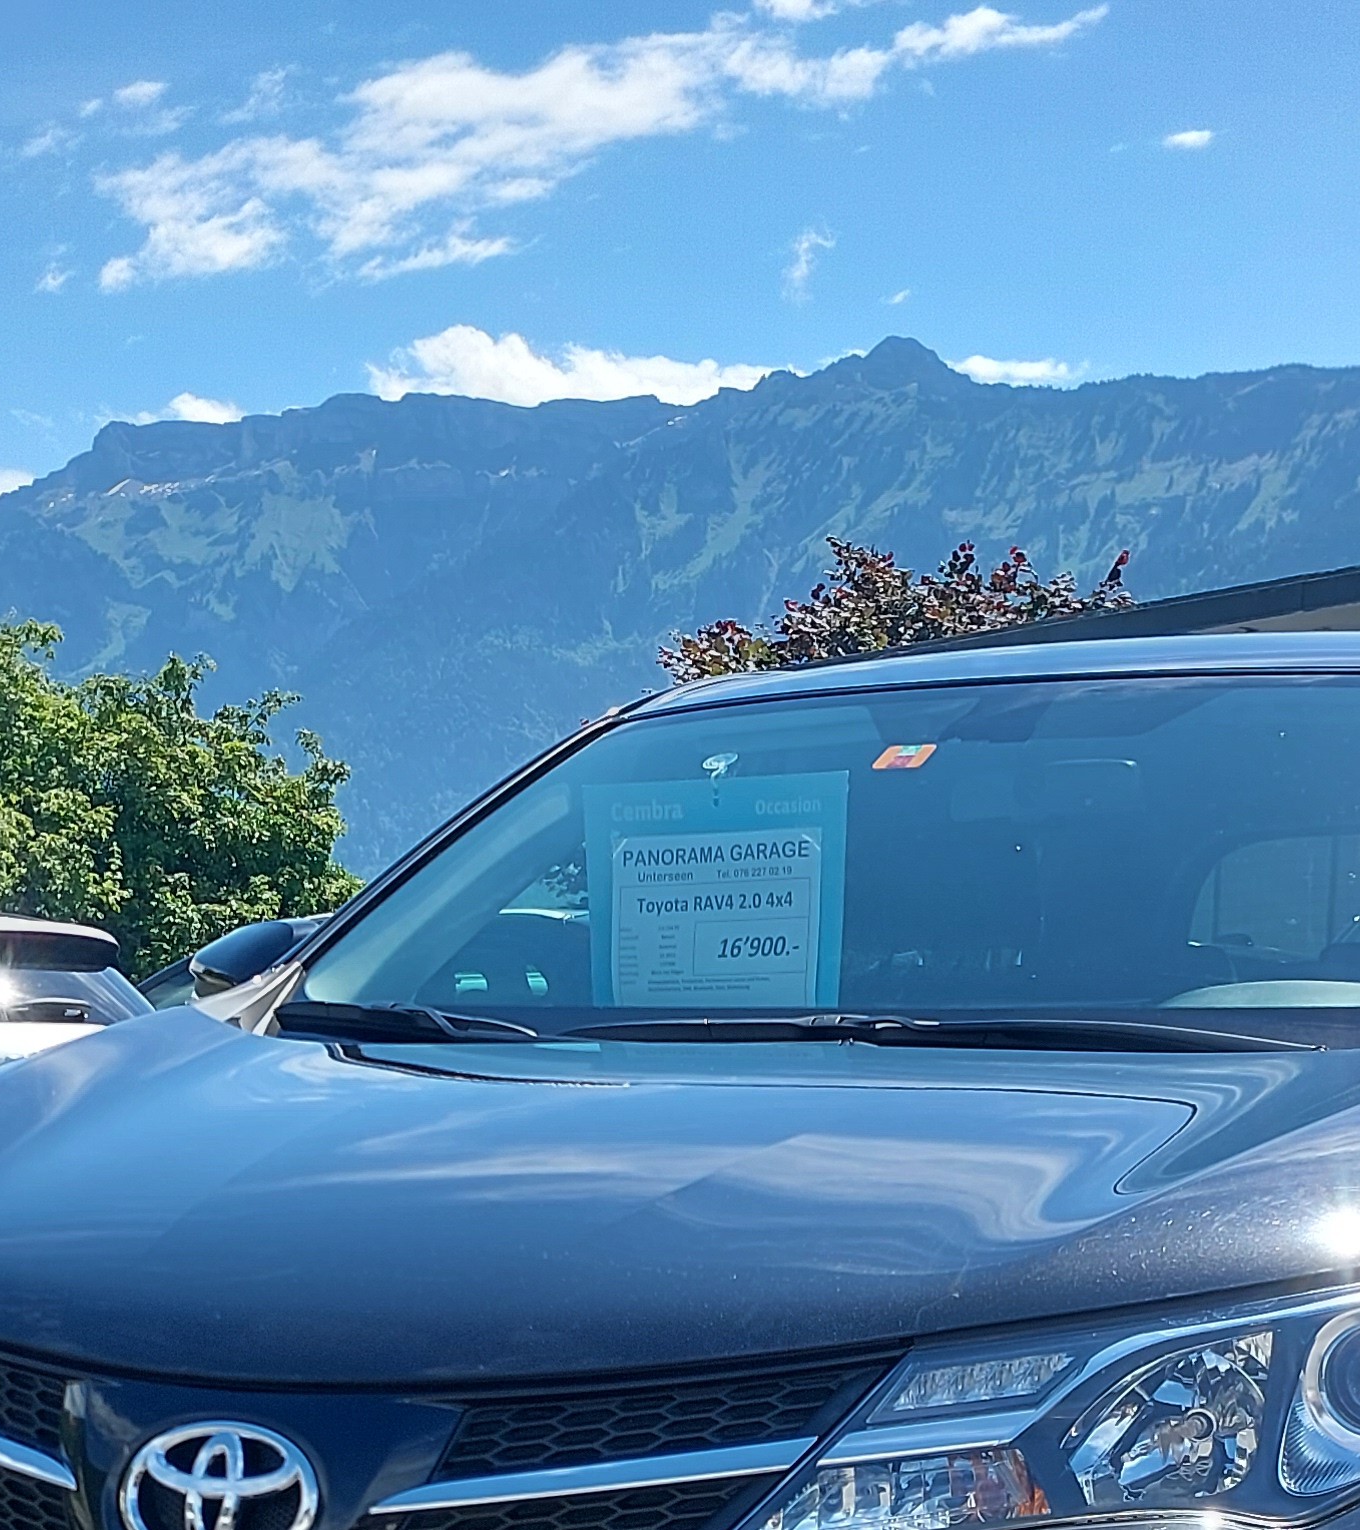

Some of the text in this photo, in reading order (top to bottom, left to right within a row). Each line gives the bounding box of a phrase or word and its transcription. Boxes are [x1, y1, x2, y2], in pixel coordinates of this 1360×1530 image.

[611, 799, 684, 822] Cembra
[755, 796, 822, 816] Occasion
[623, 840, 811, 868] PANORAMA GARAGE
[637, 870, 694, 883] Unterseen
[637, 890, 793, 916] Toyota RAV4 2.0 4x4
